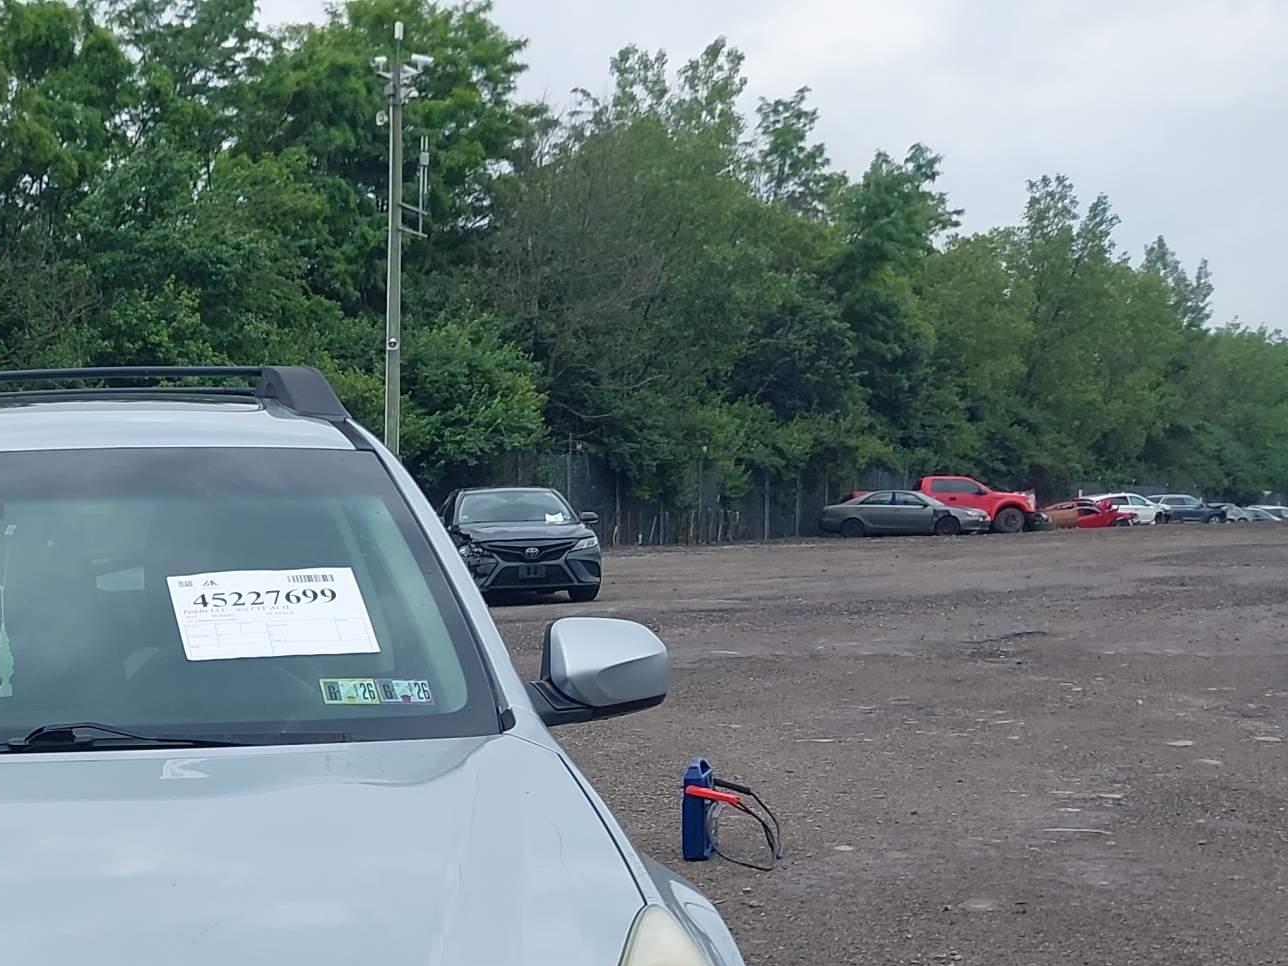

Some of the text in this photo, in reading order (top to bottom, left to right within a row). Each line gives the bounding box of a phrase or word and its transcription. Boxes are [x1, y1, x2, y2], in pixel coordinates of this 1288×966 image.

[192, 588, 337, 608] 45227699
[359, 682, 376, 700] 26
[414, 682, 431, 700] 26
